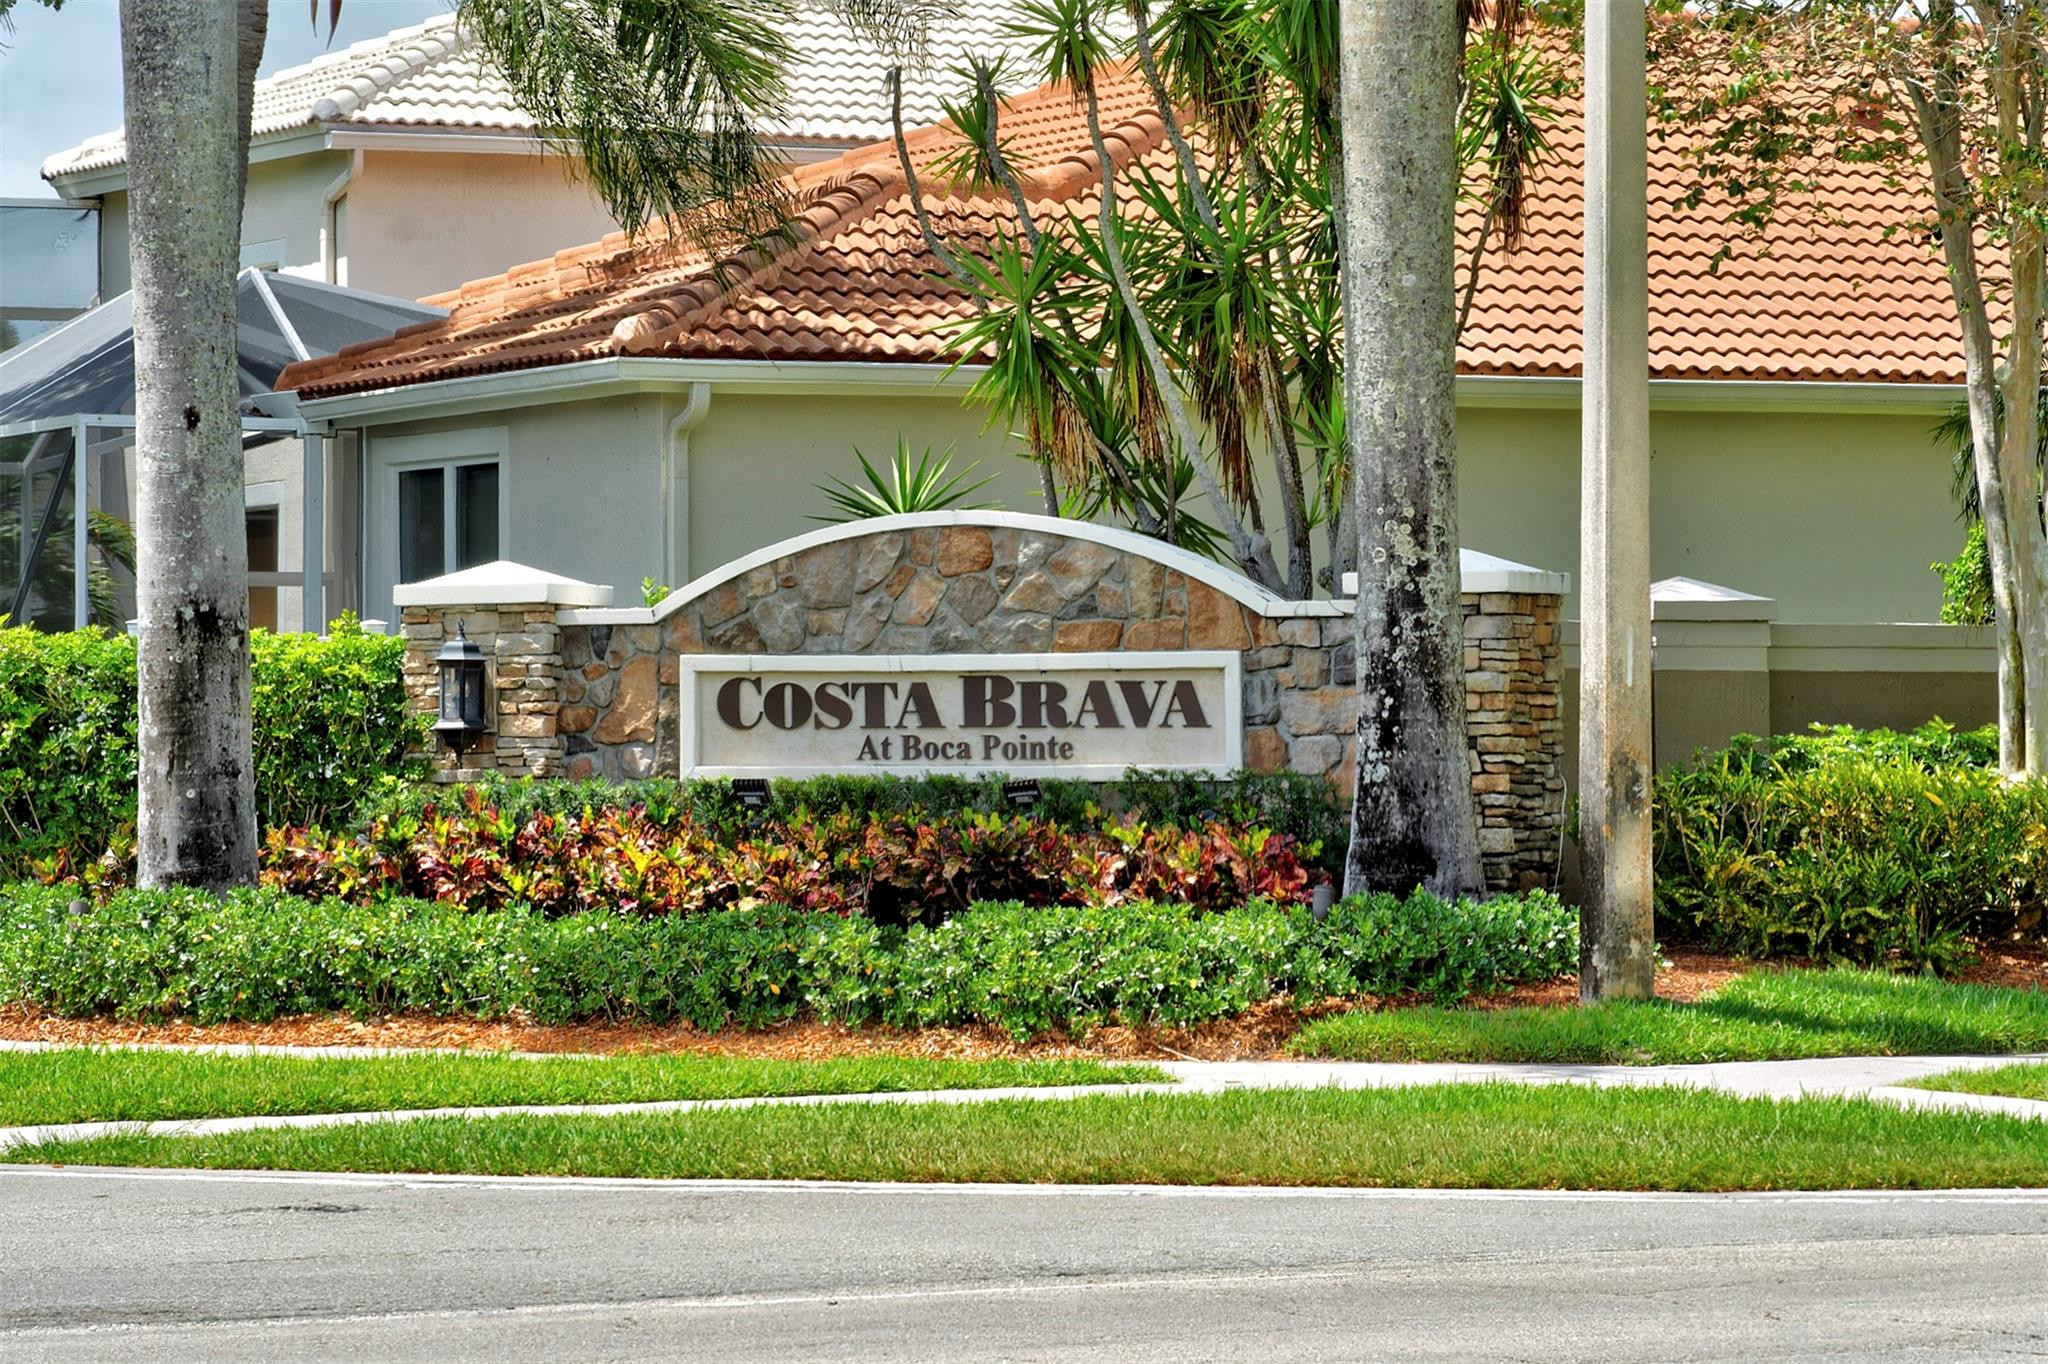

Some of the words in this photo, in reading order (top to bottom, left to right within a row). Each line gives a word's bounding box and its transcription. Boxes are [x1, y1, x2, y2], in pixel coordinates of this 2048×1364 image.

[716, 676, 946, 731] COSTA
[958, 675, 1212, 730] BRAVA
[856, 734, 893, 762] At
[900, 734, 973, 762] Boca
[981, 734, 1075, 762] Pointe
